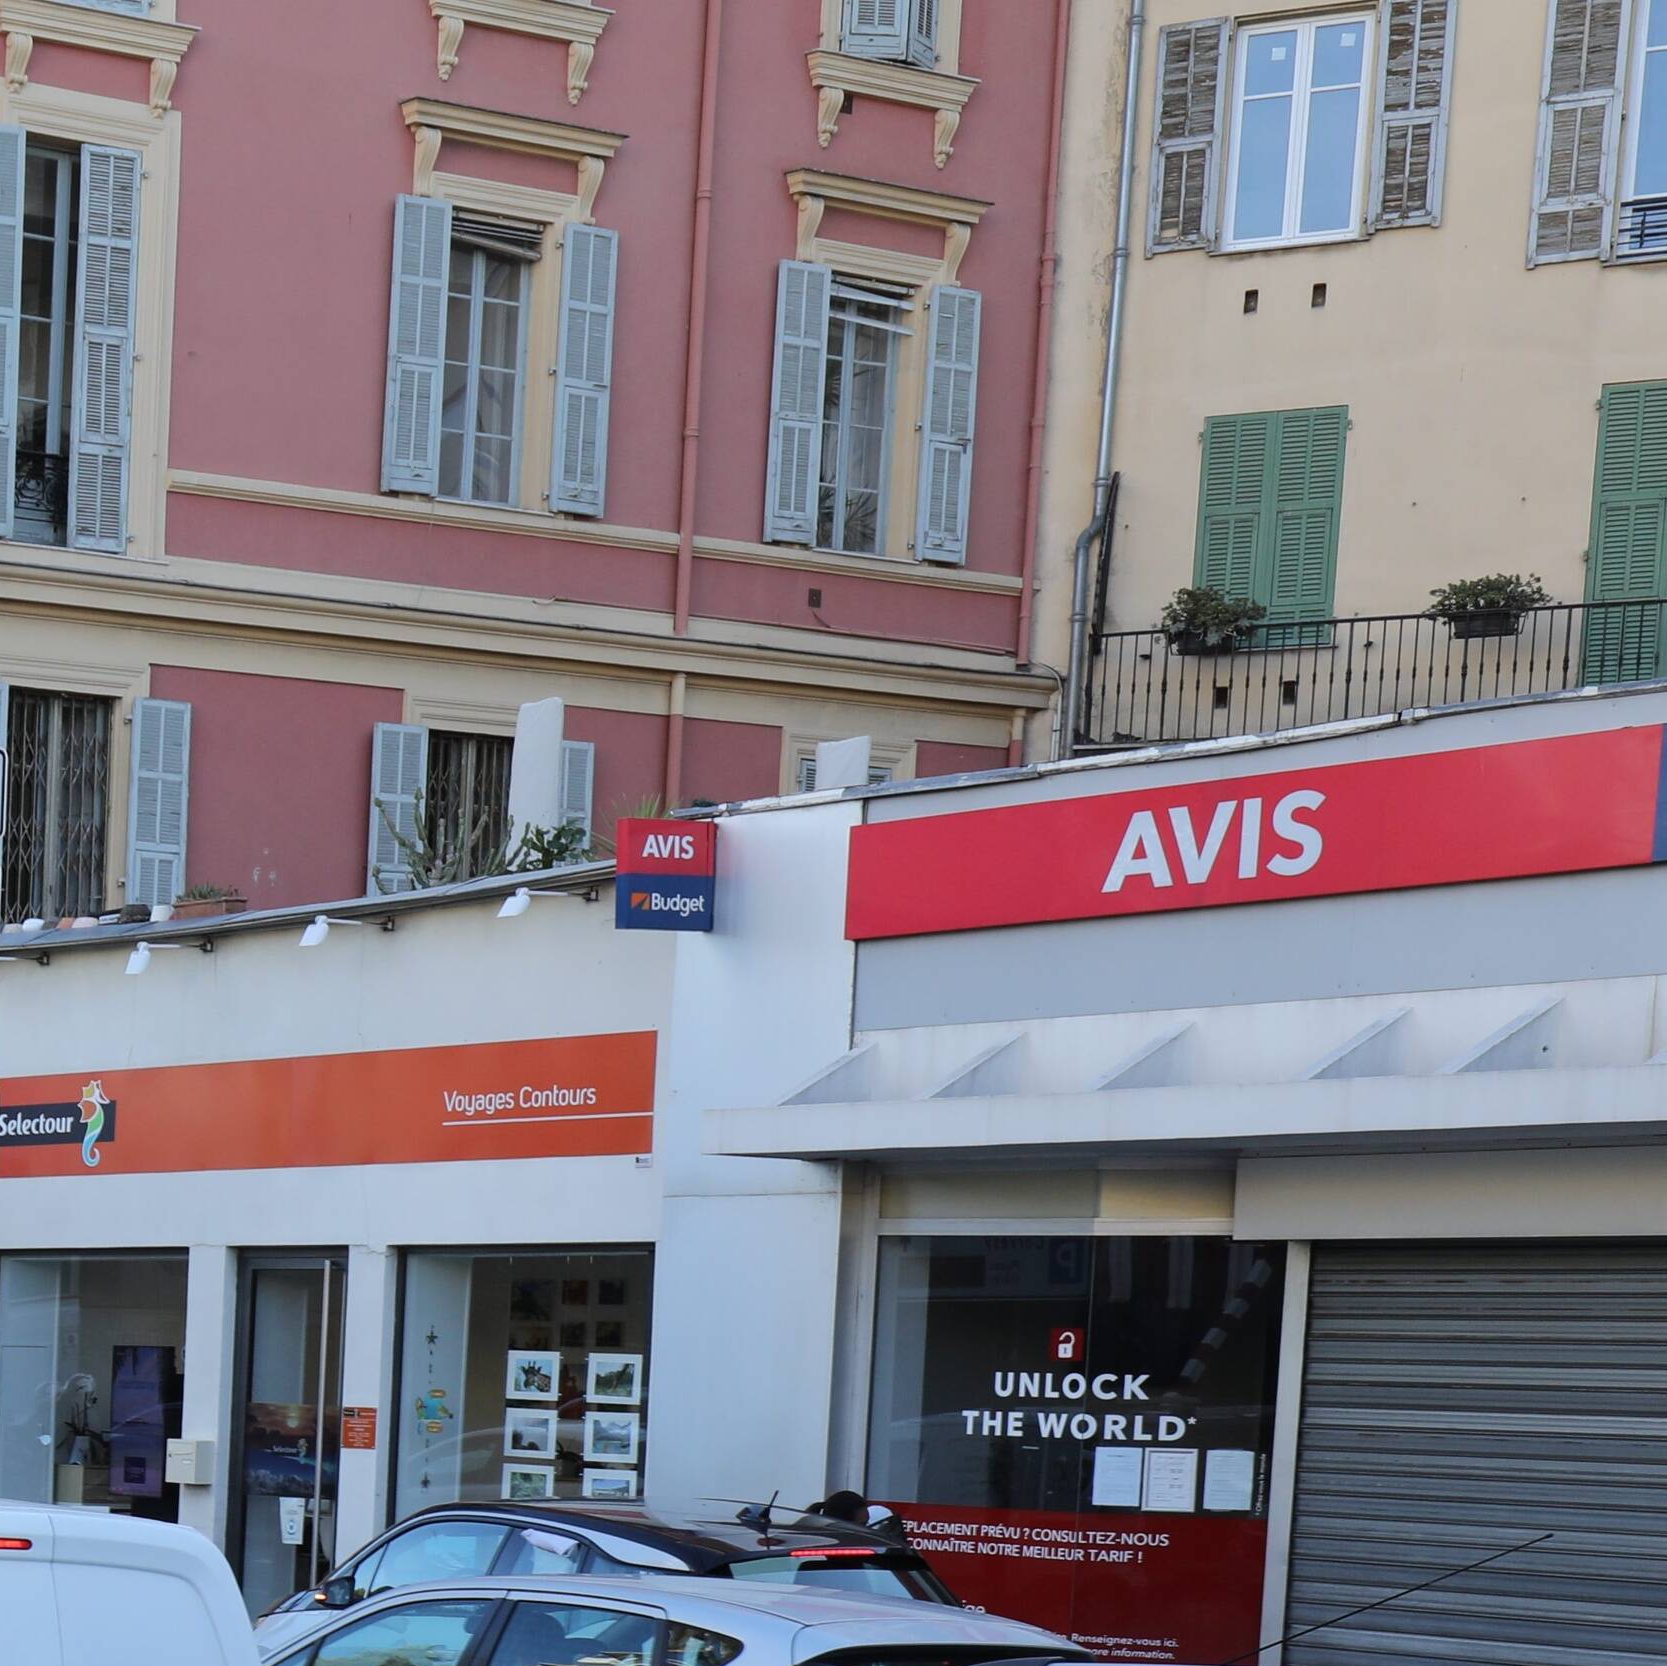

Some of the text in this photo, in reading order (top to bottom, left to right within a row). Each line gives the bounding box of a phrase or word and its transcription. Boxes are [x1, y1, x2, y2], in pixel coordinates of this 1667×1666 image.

[642, 834, 694, 859] AVIS
[1101, 789, 1326, 893] AVIS
[651, 892, 706, 917] Budget
[444, 1084, 596, 1116] Voyages Contours
[994, 1371, 1150, 1400] UNLOCK
[962, 1410, 1024, 1437] THE
[980, 1523, 1020, 1539] PRÉVU
[1023, 1527, 1030, 1540] ?
[1032, 1528, 1169, 1547] CONSULTEZ-NOUS
[977, 1541, 1020, 1557] NOTRE
[1022, 1545, 1084, 1561] MEILLEUR
[1087, 1549, 1133, 1563] TARIF
[1071, 1632, 1161, 1646] Renseignez-vous
[1111, 1647, 1175, 1660] information.
